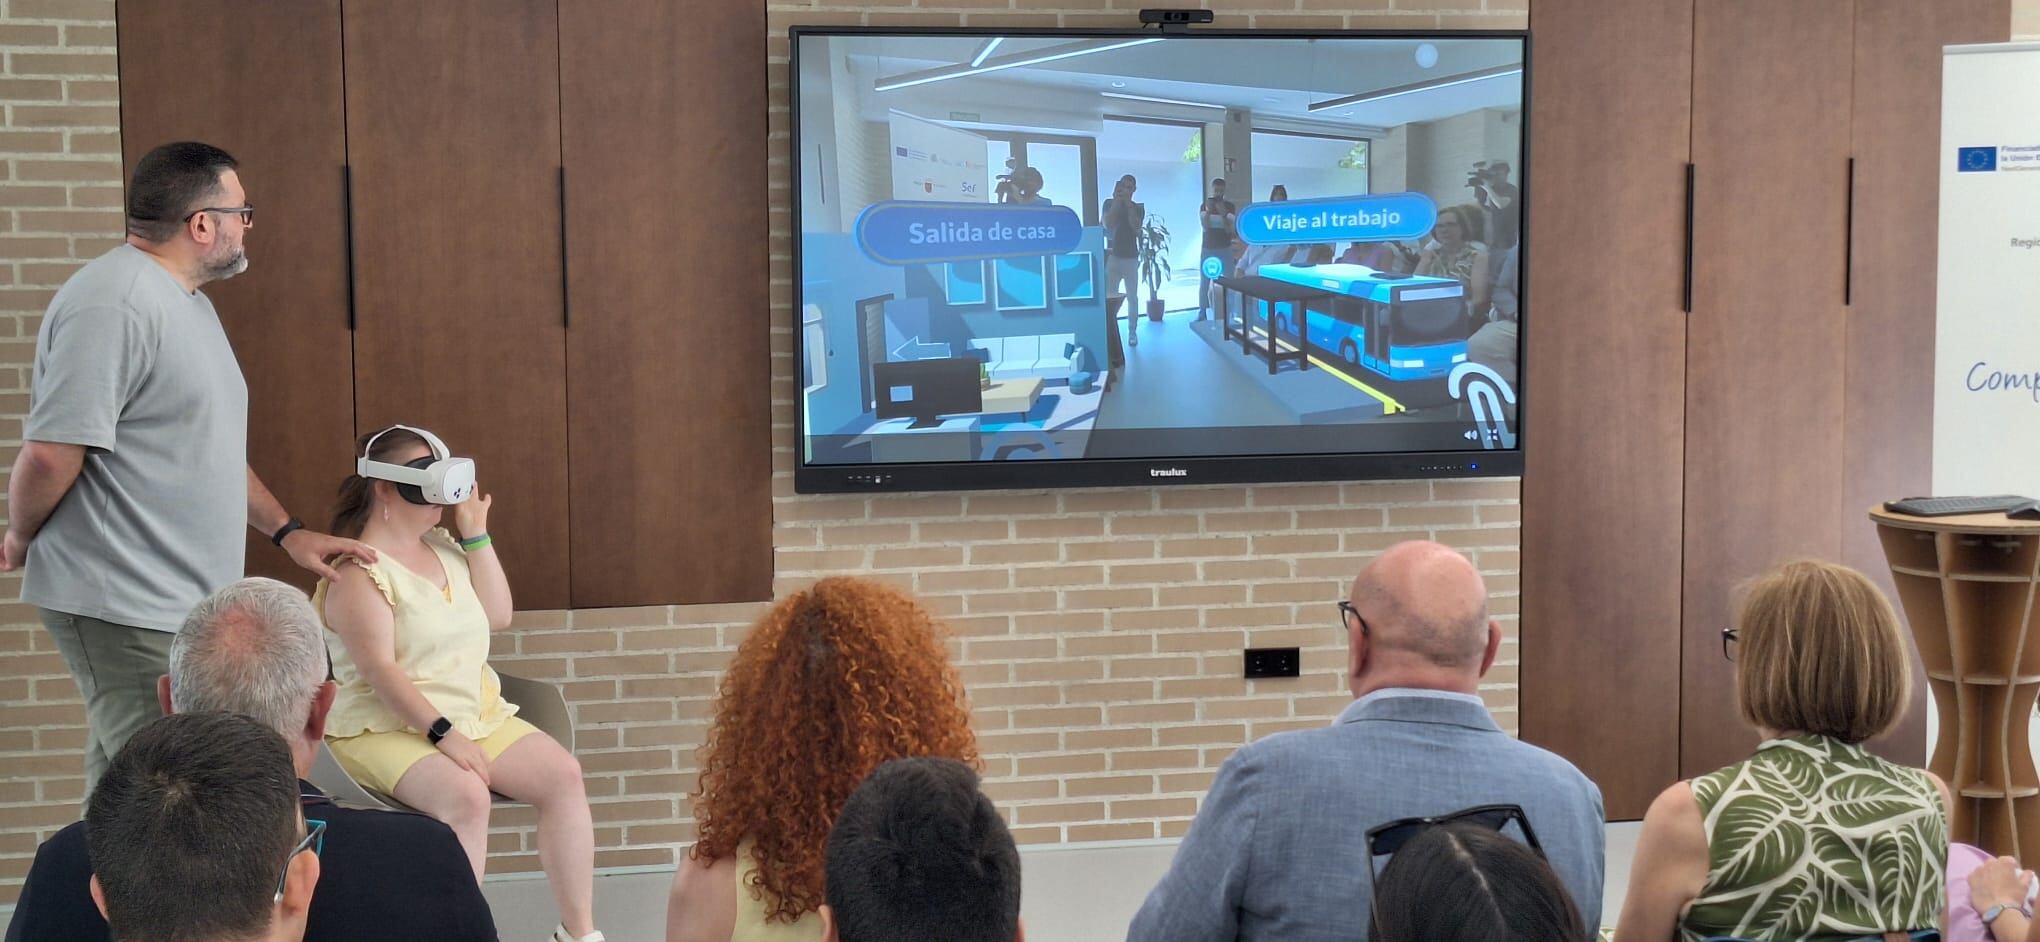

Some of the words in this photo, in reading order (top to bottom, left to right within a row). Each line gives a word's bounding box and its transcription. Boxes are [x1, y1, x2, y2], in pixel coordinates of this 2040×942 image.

[1263, 213, 1308, 233] Viaje
[1311, 212, 1327, 228] al
[1331, 208, 1401, 229] trabajo
[909, 222, 983, 245] Salida
[988, 222, 1013, 241] de
[1017, 225, 1056, 240] casa
